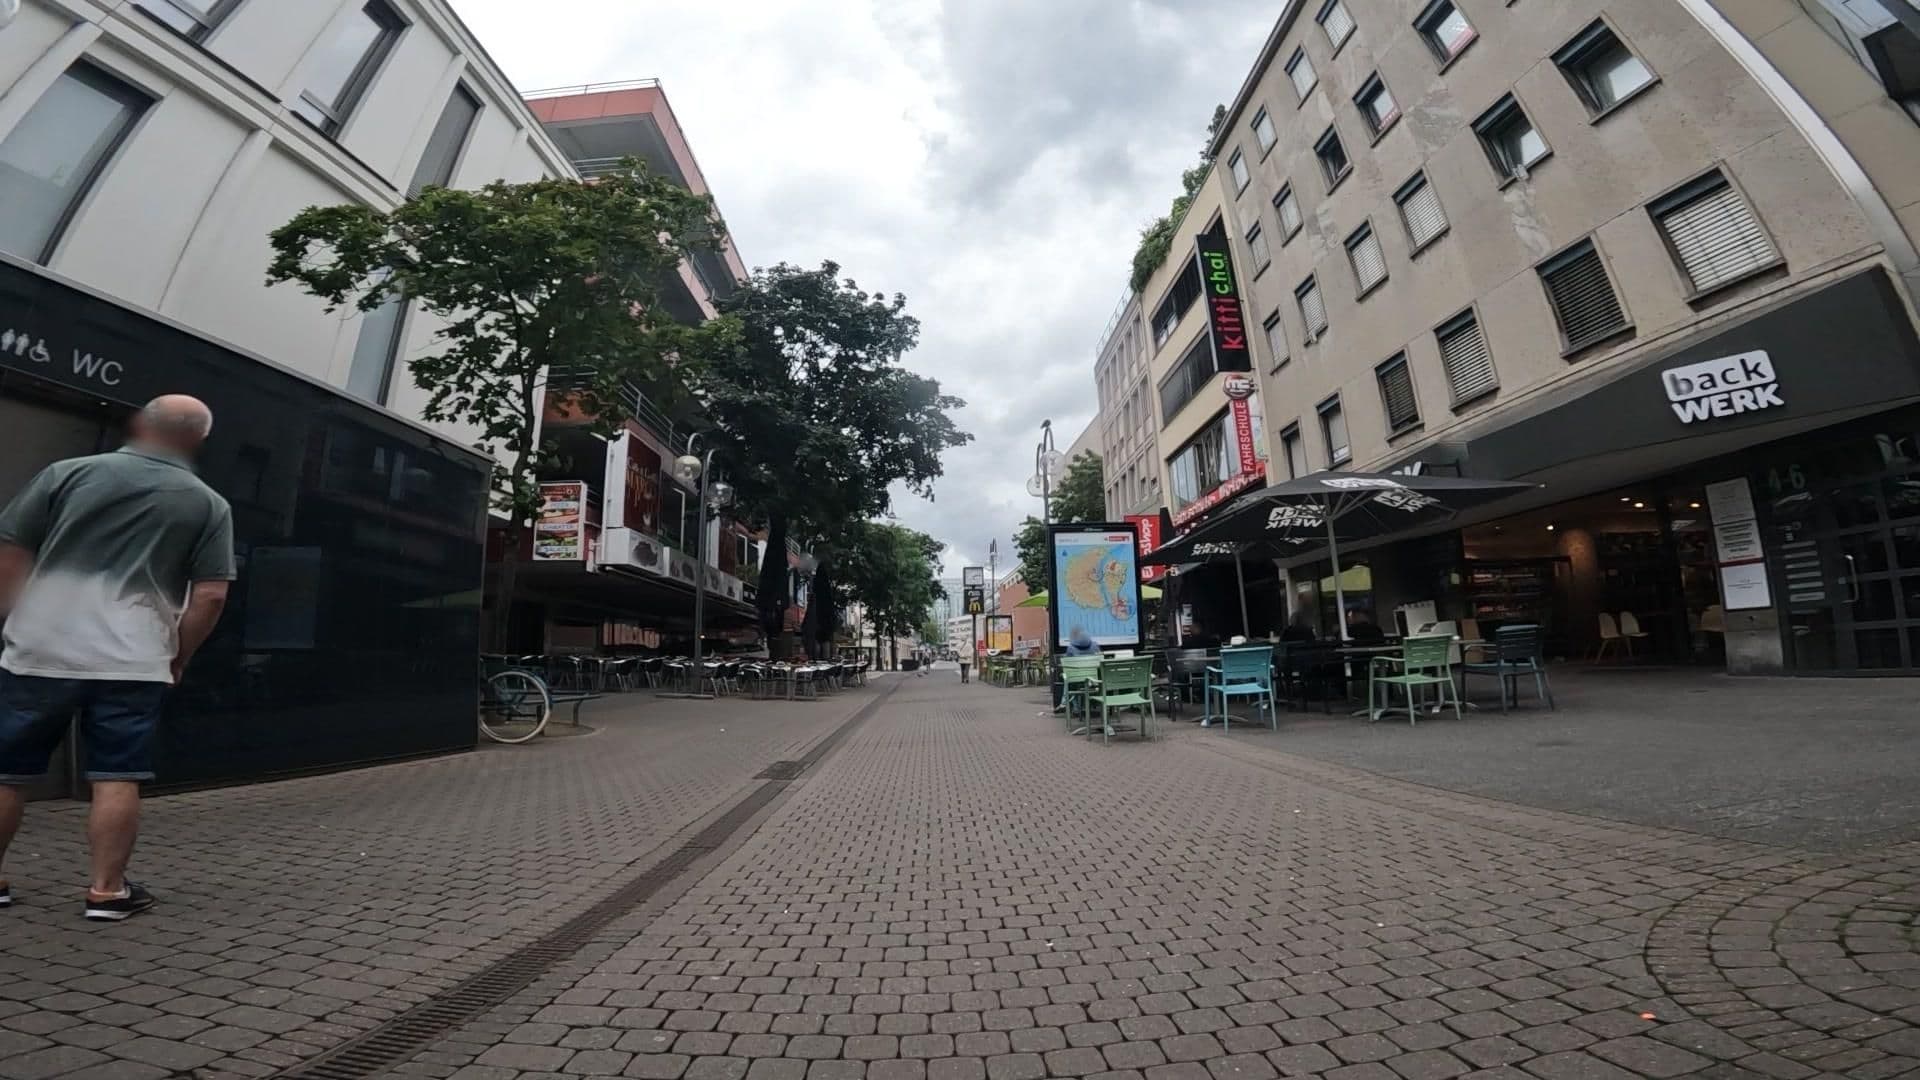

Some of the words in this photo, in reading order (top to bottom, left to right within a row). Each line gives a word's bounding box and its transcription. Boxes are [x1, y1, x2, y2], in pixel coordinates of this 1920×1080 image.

[72, 348, 125, 386] WC
[1669, 358, 1767, 396] back
[1671, 383, 1785, 424] WERK
[1235, 400, 1254, 472] FAHRSCHULE
